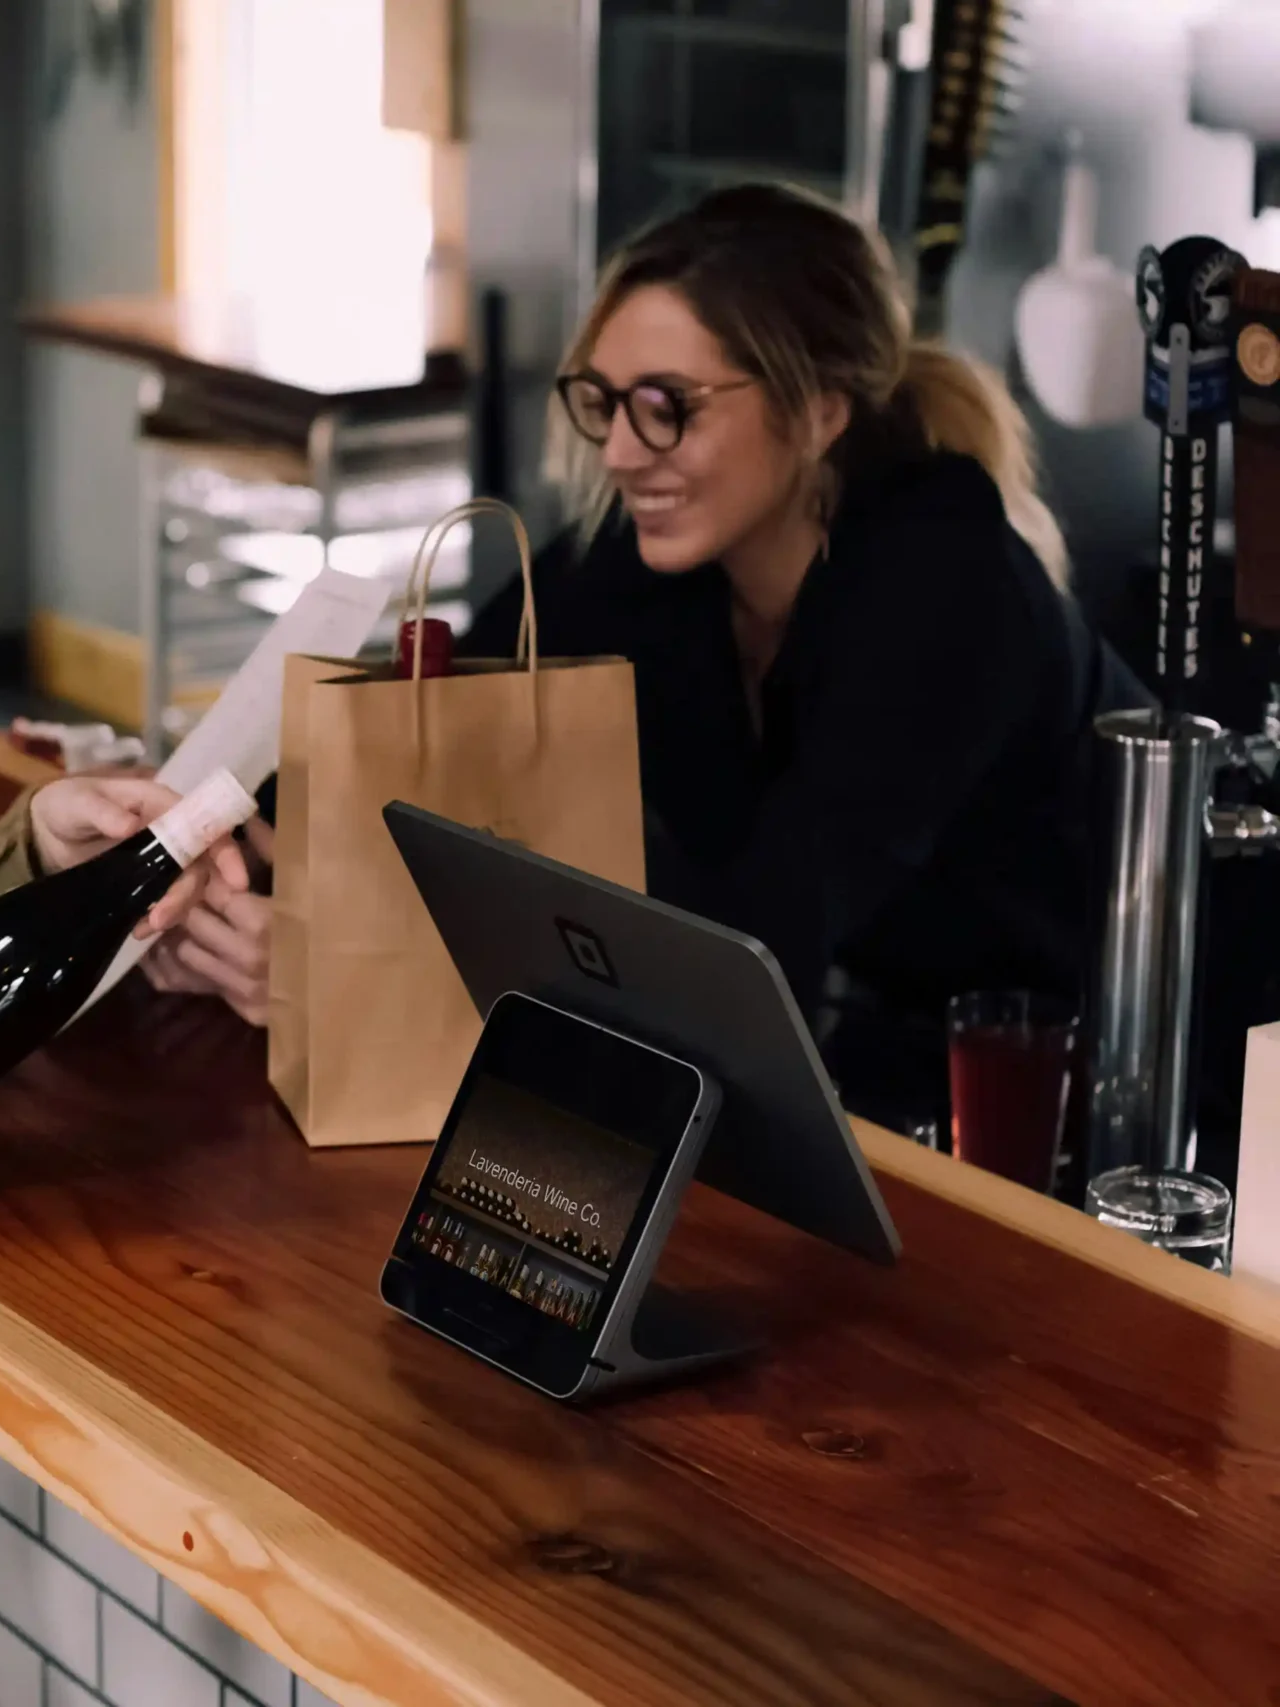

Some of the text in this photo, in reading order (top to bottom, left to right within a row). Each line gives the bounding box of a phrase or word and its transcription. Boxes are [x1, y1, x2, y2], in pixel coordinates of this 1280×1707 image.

[1183, 437, 1208, 680] DESCHUTES
[468, 1148, 602, 1229] Lavenderia Wine Co.
